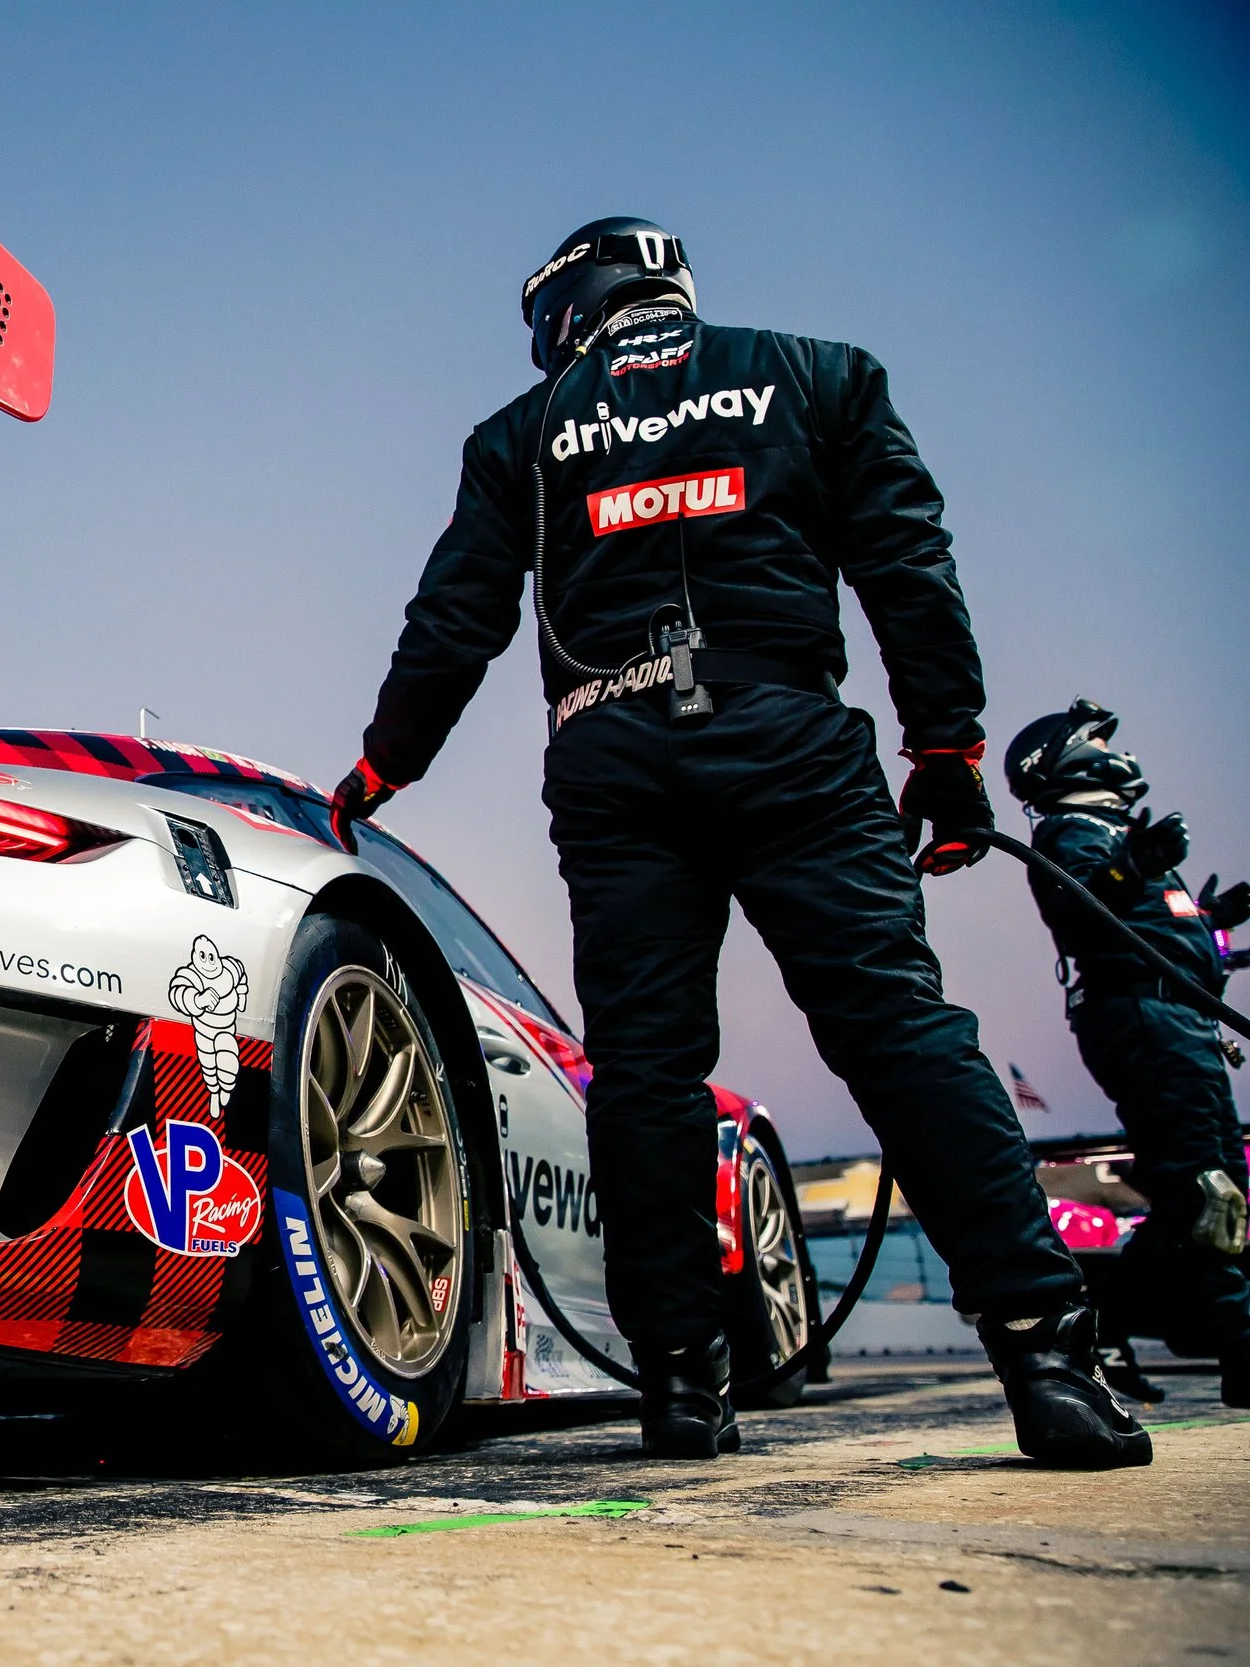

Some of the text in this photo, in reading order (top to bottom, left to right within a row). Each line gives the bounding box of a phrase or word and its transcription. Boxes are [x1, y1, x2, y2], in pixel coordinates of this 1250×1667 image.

[610, 340, 694, 371] PFAFF
[610, 352, 690, 377] MOTORSPORTS
[551, 384, 776, 462] driveway
[598, 475, 738, 530] MOTUL
[600, 655, 674, 702] RADIO
[126, 1118, 224, 1254] VP
[191, 1193, 258, 1237] Racing
[191, 1238, 239, 1254] FUELS
[285, 1216, 388, 1424] MICHELIN
